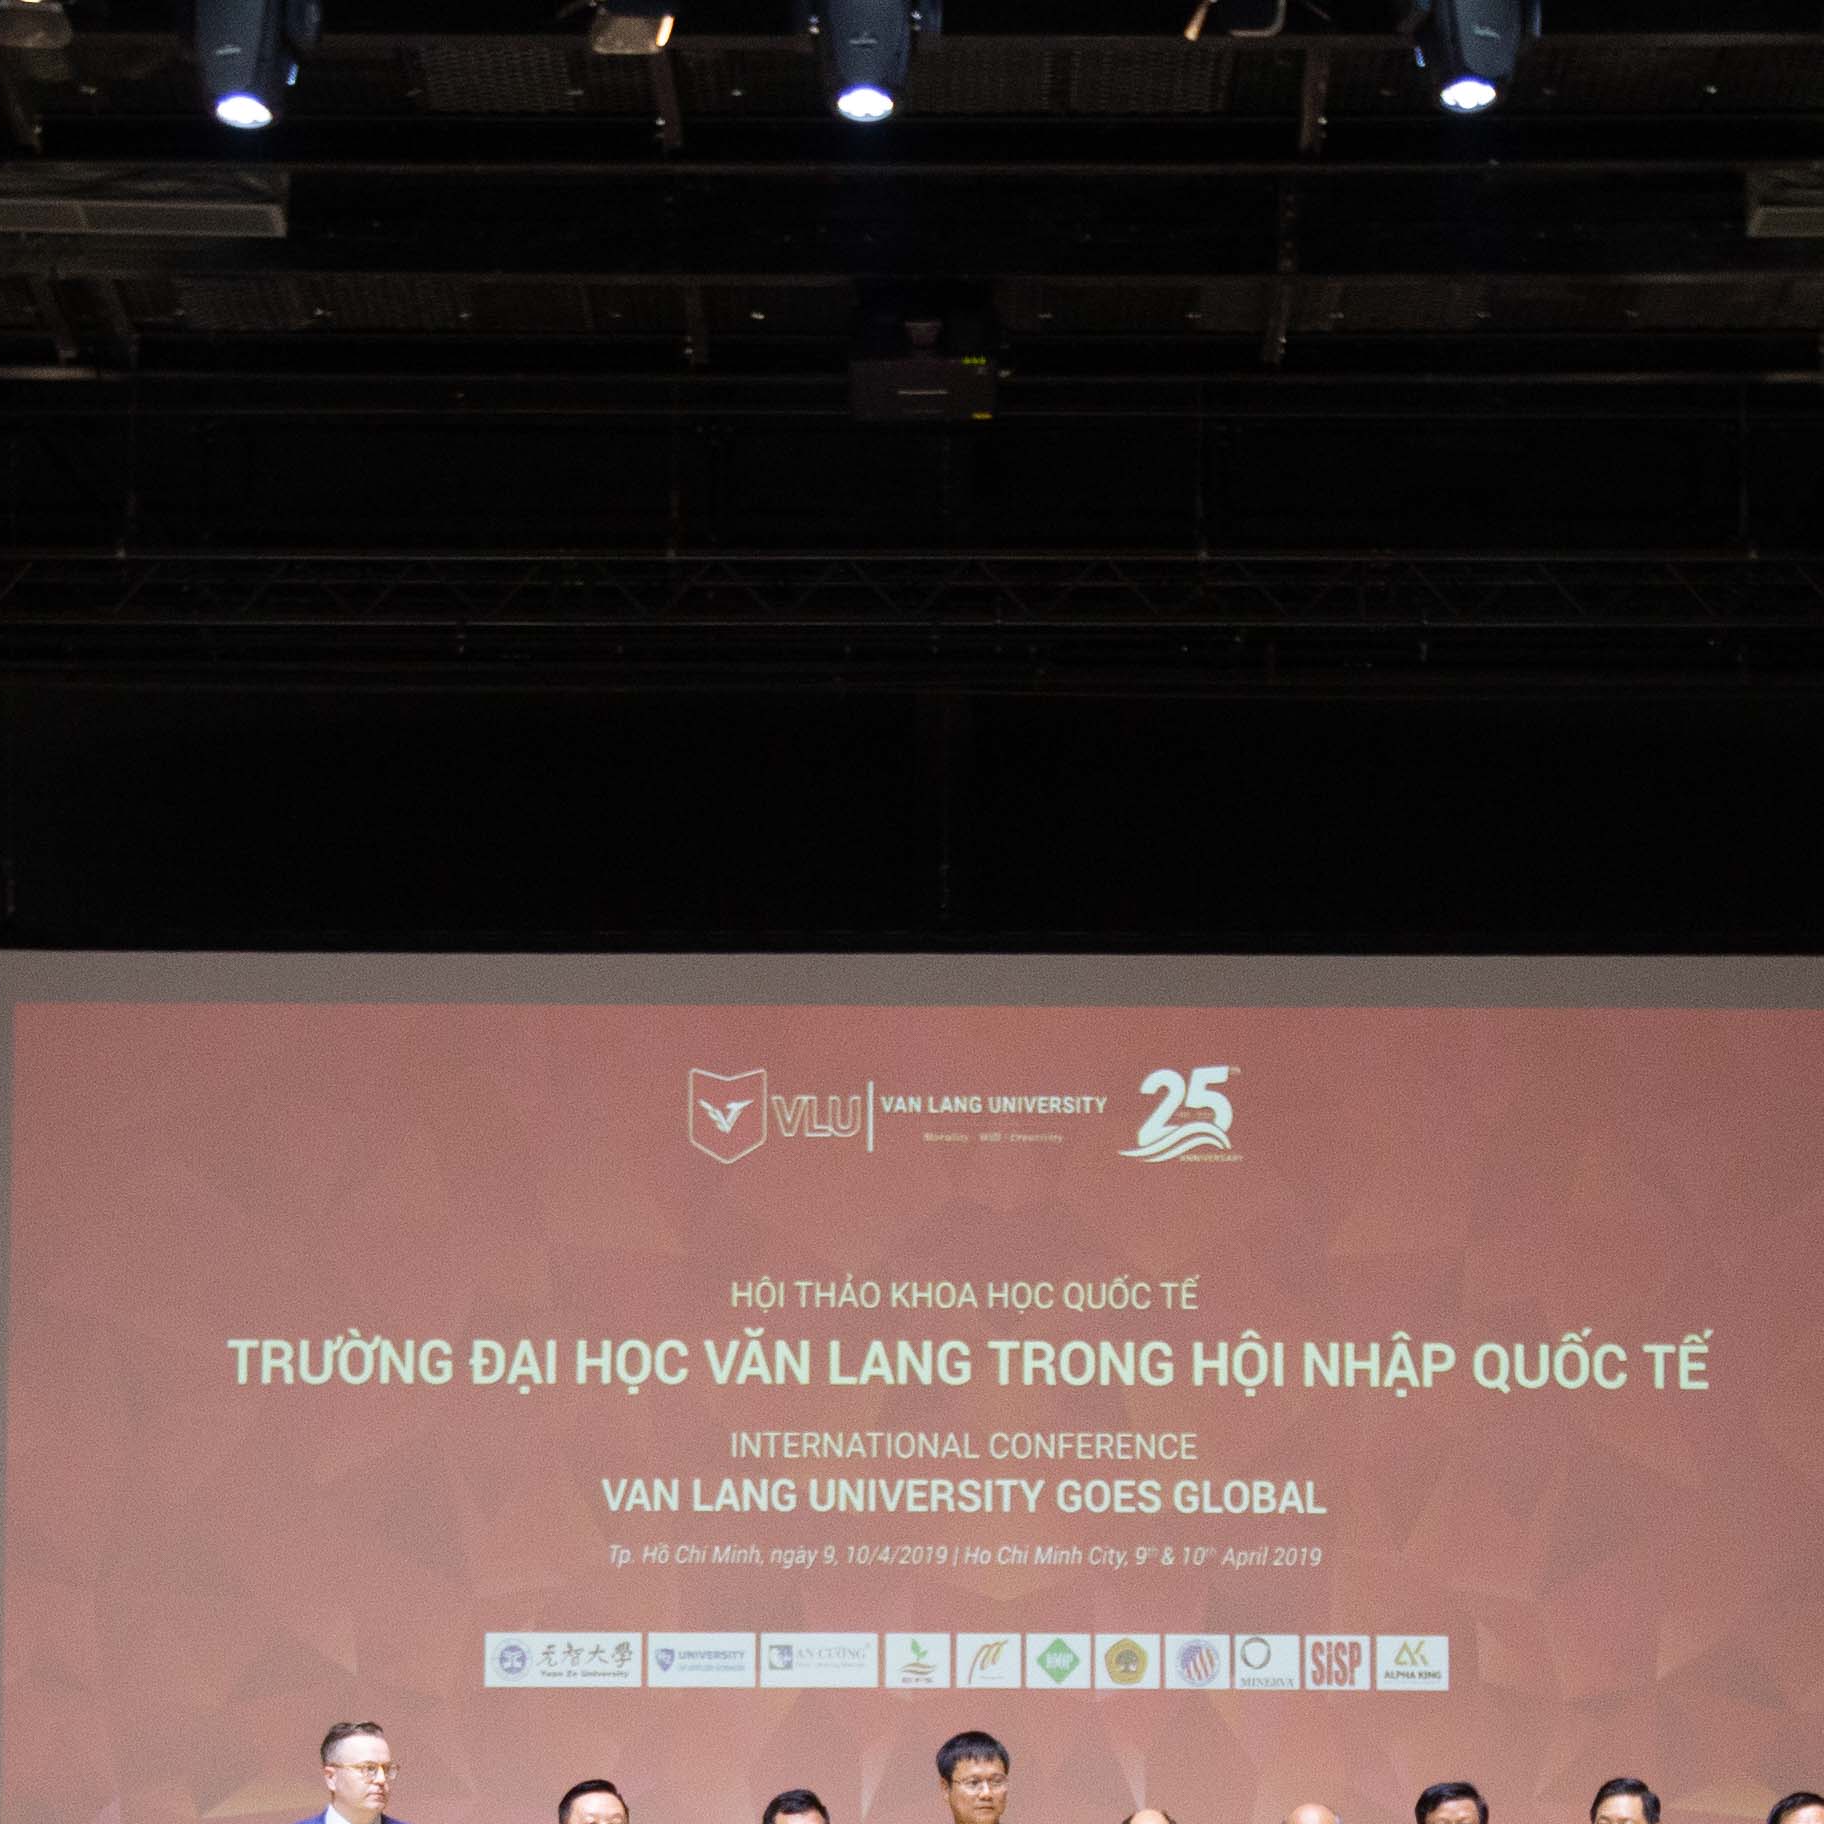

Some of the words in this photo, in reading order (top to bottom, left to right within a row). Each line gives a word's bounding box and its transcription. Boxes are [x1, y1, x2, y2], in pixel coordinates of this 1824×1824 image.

[771, 1095, 861, 1137] VLU
[881, 1096, 921, 1112] VAN
[928, 1096, 982, 1113] LANG
[988, 1096, 1106, 1113] UNIVERSITY
[732, 1276, 784, 1313] HỘI
[794, 1273, 880, 1308] THẢO
[891, 1281, 977, 1308] KHOA
[988, 1282, 1053, 1313] HỌC
[1063, 1275, 1150, 1312] QUỐC
[1160, 1275, 1199, 1309] TẾ
[228, 1328, 452, 1384] TRƯỜNG
[469, 1340, 556, 1394] ĐẠI
[577, 1339, 688, 1394] HỌC
[704, 1328, 809, 1384] VĂN
[830, 1340, 971, 1385] LANG
[988, 1341, 1173, 1386] TRONG
[1193, 1330, 1283, 1396] HỘI
[1304, 1331, 1455, 1397] NHẬP
[1474, 1328, 1627, 1393] QUỐC
[1643, 1329, 1712, 1389] TẾ
[731, 1431, 979, 1458] INTERNATIONAL
[989, 1432, 1197, 1460] CONFERENCE
[602, 1479, 678, 1511] VAN
[693, 1478, 796, 1512] LANG
[809, 1479, 1044, 1512] UNIVERSITY
[1057, 1479, 1161, 1513] GOES
[1174, 1480, 1326, 1513] GLOBAL
[610, 1544, 635, 1568] Tp.
[642, 1543, 669, 1564] Hồ
[712, 1544, 764, 1567] Minh,
[823, 1545, 839, 1567] 9,
[847, 1545, 949, 1566] 10/4/2019
[964, 1546, 990, 1565] Ho
[996, 1545, 1028, 1565] Chi
[1034, 1546, 1082, 1564] Minh
[1161, 1546, 1174, 1565] &
[1222, 1546, 1268, 1569] April
[1273, 1547, 1322, 1566] 2019
[678, 1650, 745, 1660] UNIVERSITY
